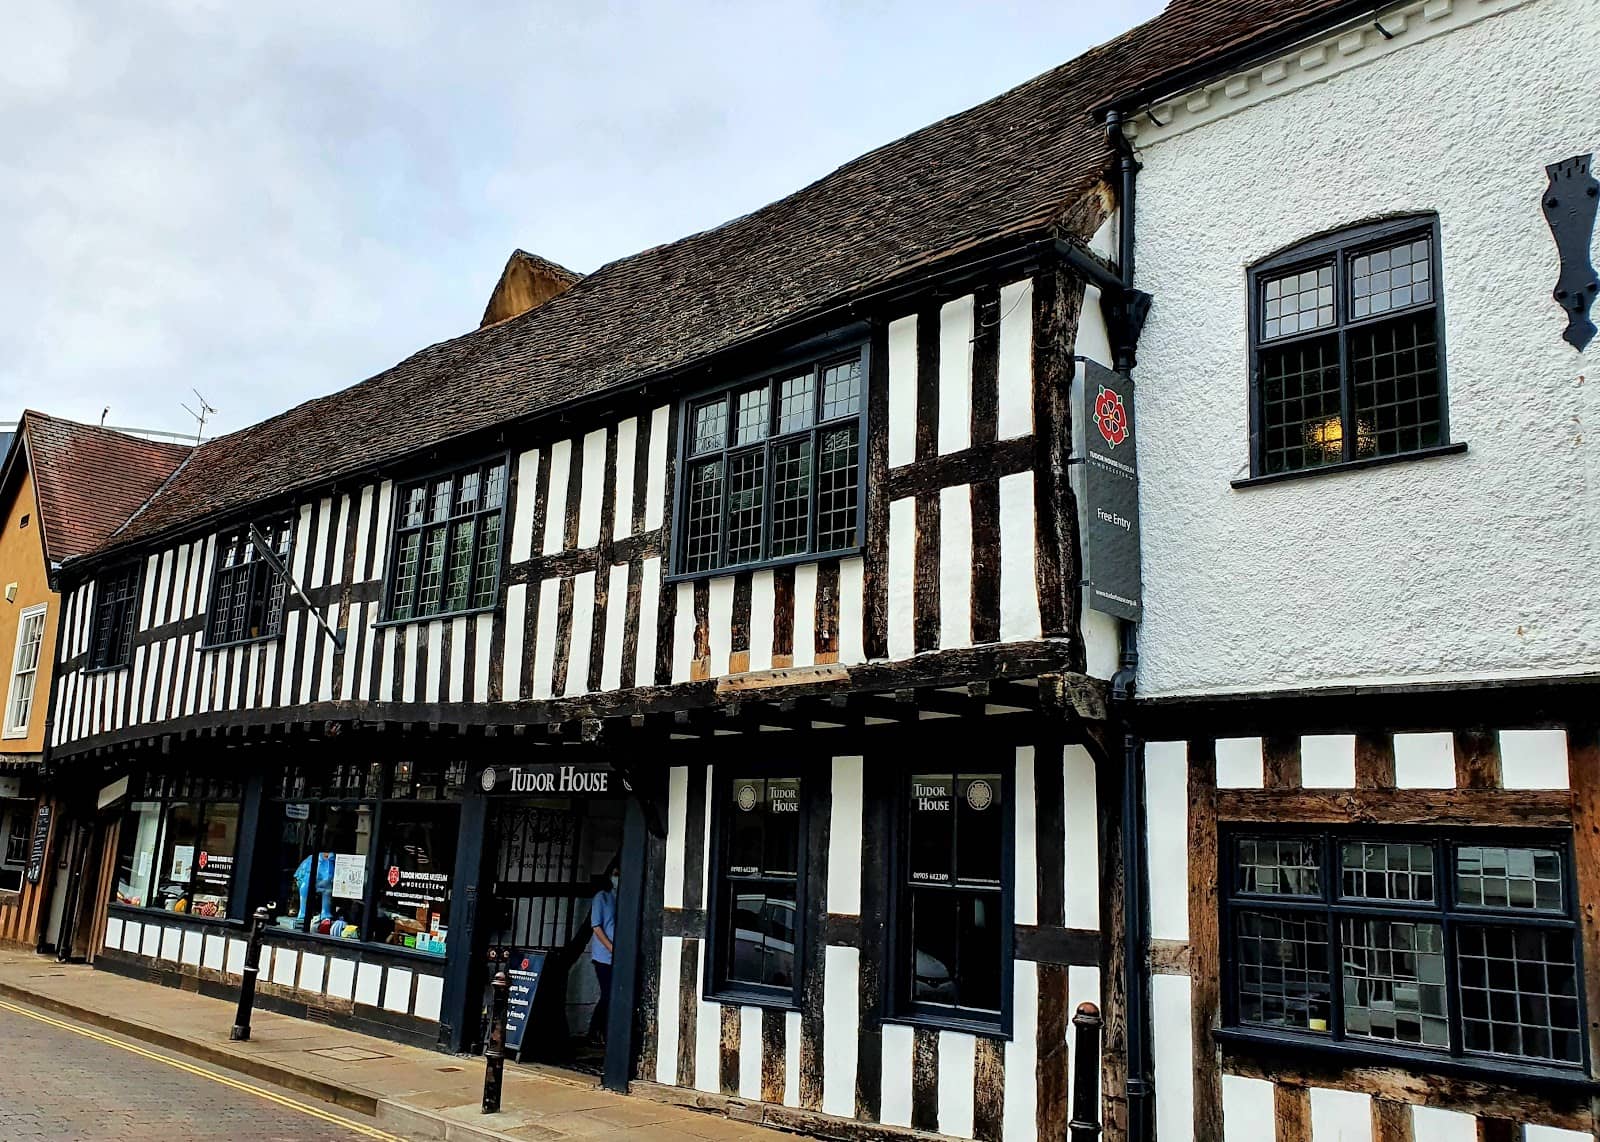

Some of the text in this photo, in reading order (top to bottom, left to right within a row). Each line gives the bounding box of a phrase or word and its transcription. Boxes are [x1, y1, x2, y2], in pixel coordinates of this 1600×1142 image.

[1097, 508, 1131, 531] Free Entry
[509, 766, 608, 792] TUDOR HOUSE
[769, 786, 796, 799] TUDOR
[913, 783, 946, 797] TUDOR
[773, 799, 799, 812] HOUSE
[918, 798, 950, 811] HOUSE
[400, 871, 415, 879] TUDOR
[415, 872, 430, 880] HOUSE
